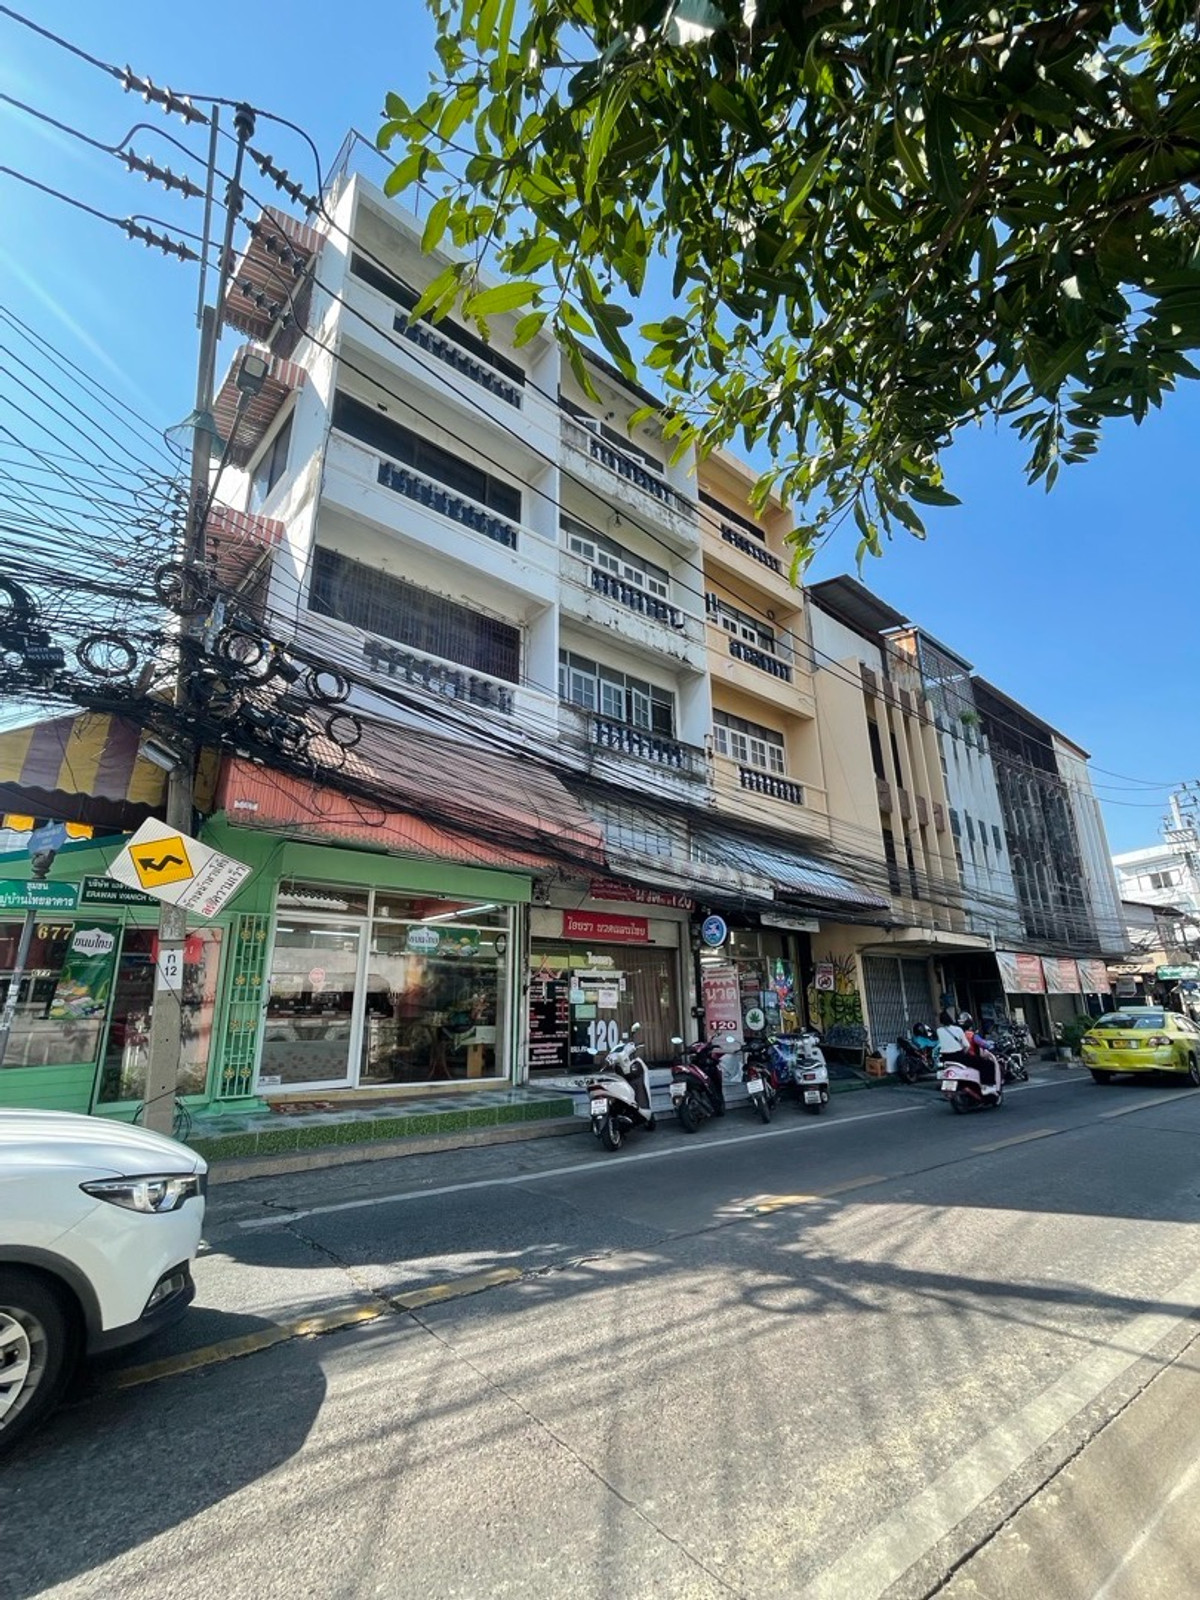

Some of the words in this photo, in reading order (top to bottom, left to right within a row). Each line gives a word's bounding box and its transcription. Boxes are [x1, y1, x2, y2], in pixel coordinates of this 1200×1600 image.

[38, 924, 71, 940] 677
[164, 966, 177, 976] 12
[711, 1021, 736, 1030] 120
[587, 1019, 618, 1052] 120
